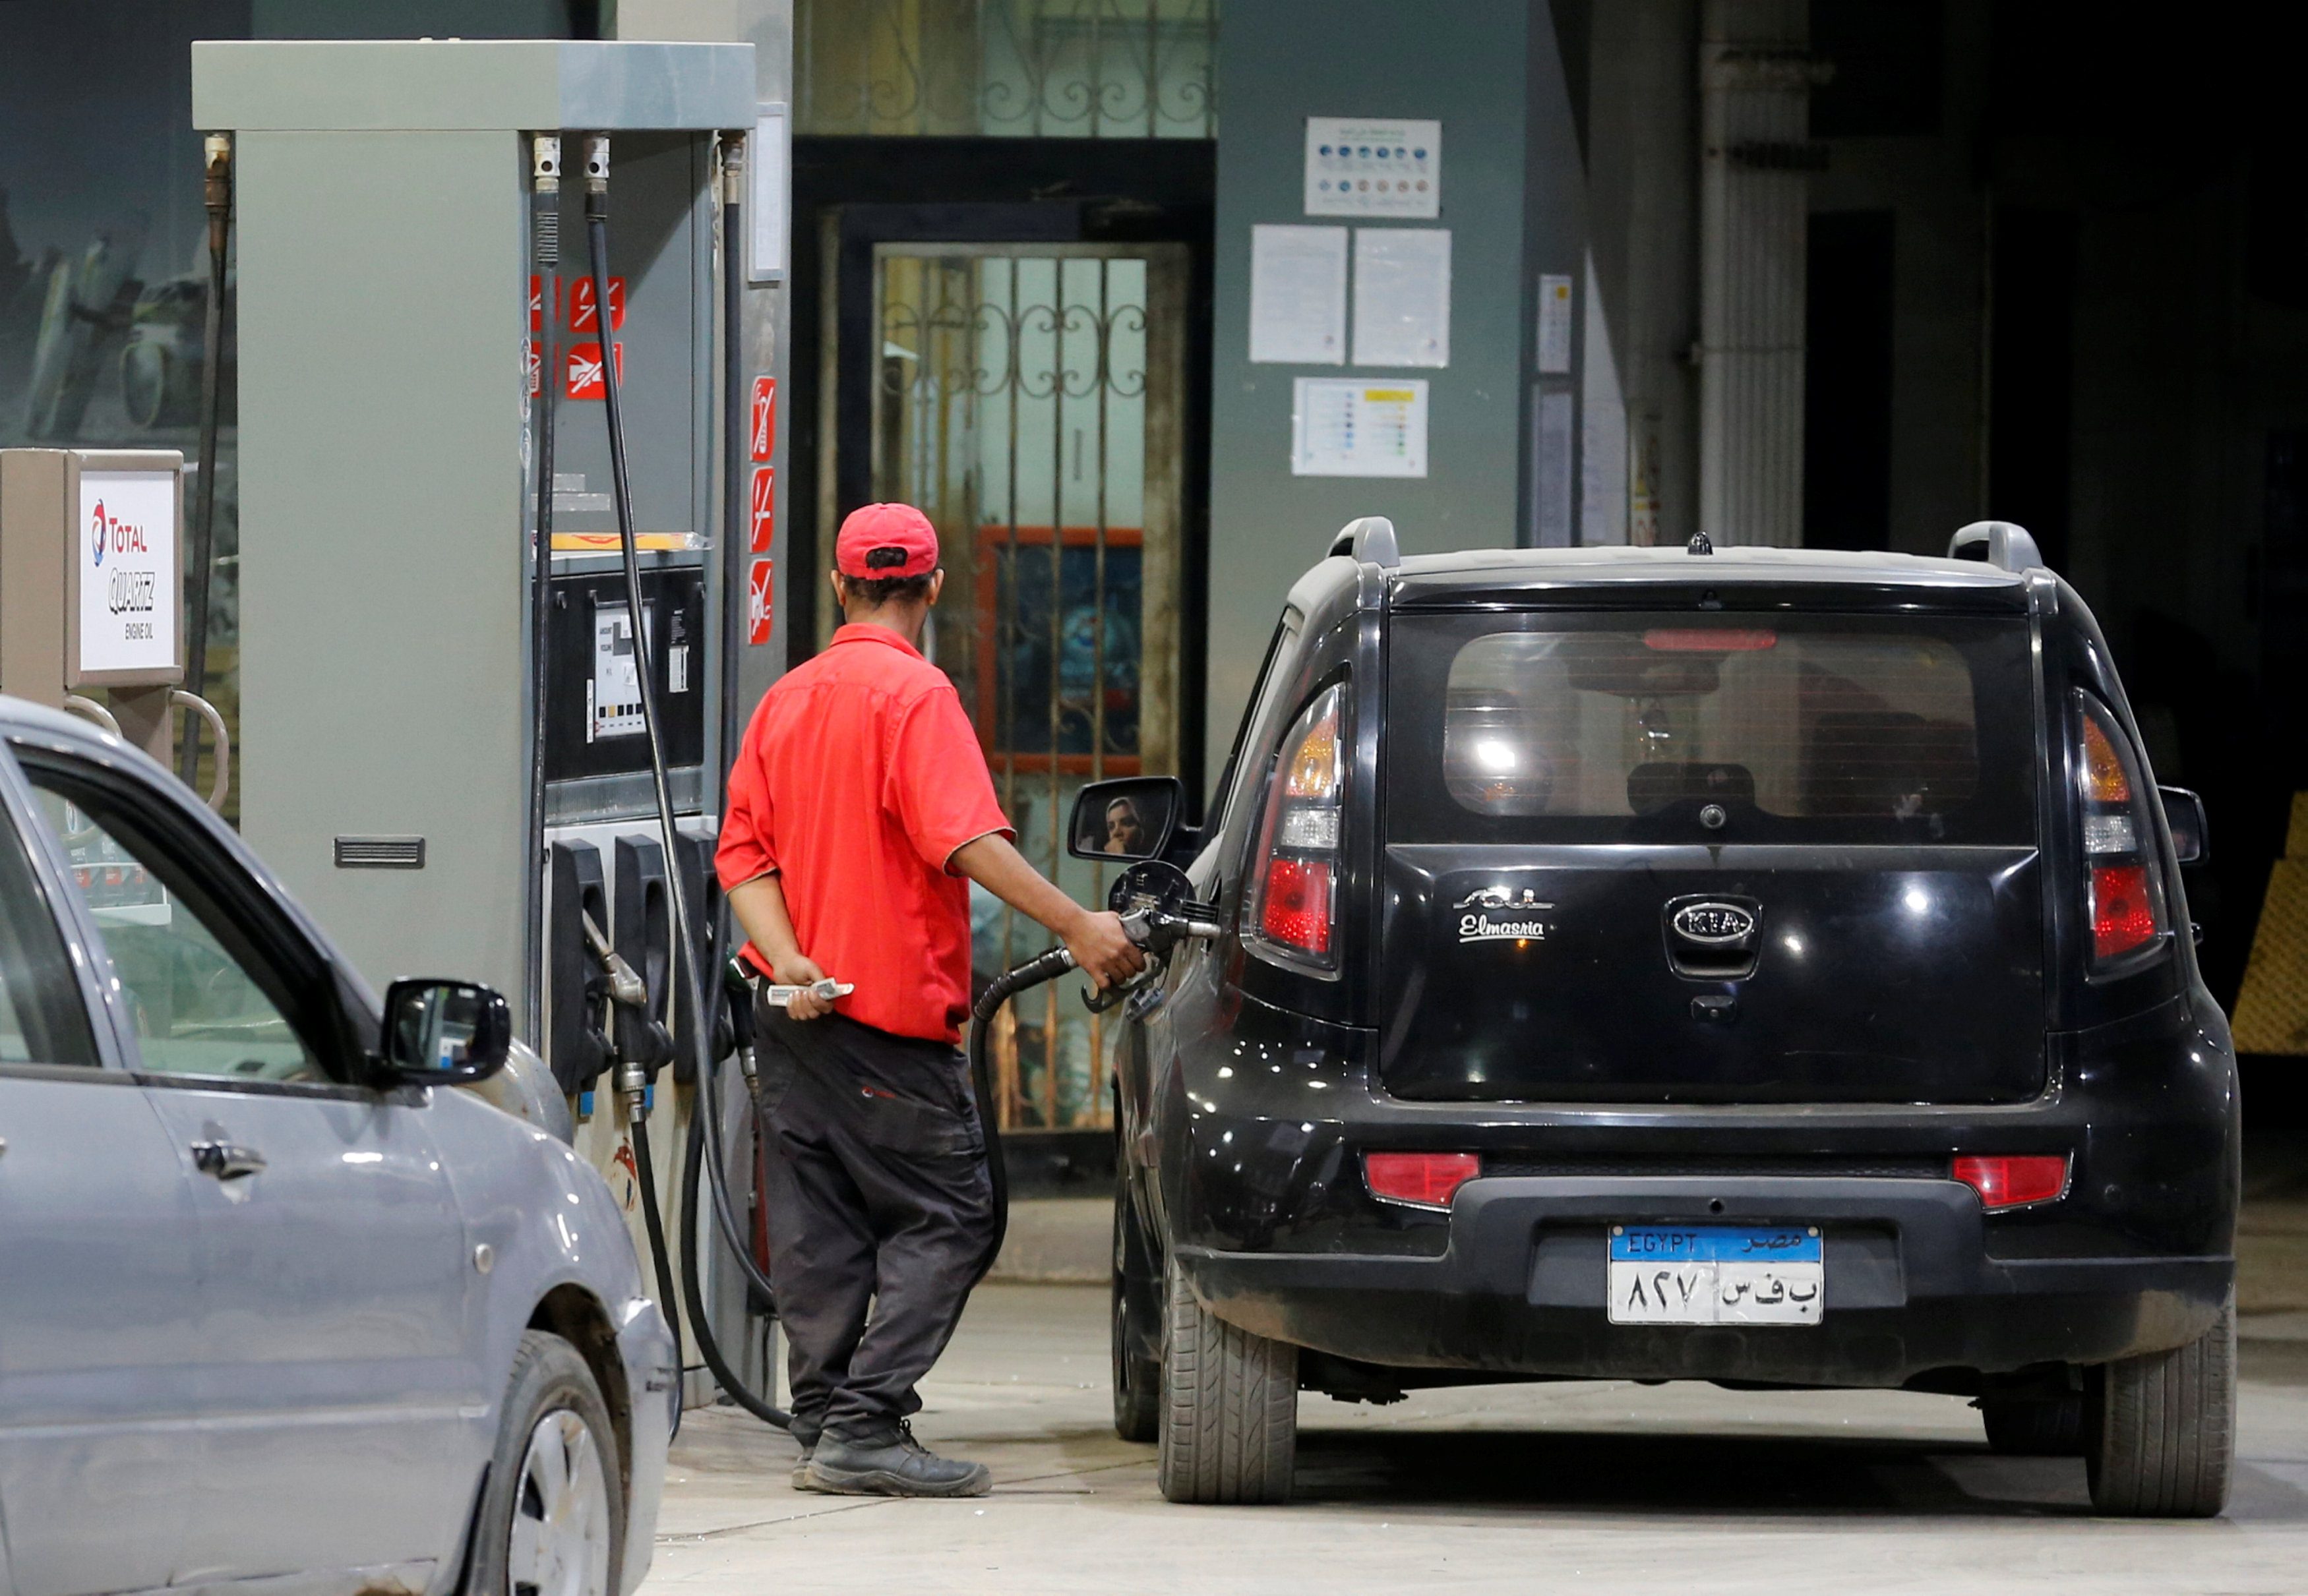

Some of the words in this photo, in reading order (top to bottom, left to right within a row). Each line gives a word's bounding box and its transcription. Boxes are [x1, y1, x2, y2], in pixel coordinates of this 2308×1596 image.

[109, 517, 147, 553] TOTAL
[108, 567, 155, 615] QUARTZ
[125, 623, 144, 639] ENGINE
[144, 623, 153, 639] OIL
[1459, 914, 1544, 936] Elmasria
[1688, 912, 1740, 932] KIA
[1628, 1233, 1697, 1253] EGYPT
[1742, 1235, 1802, 1253] مصر
